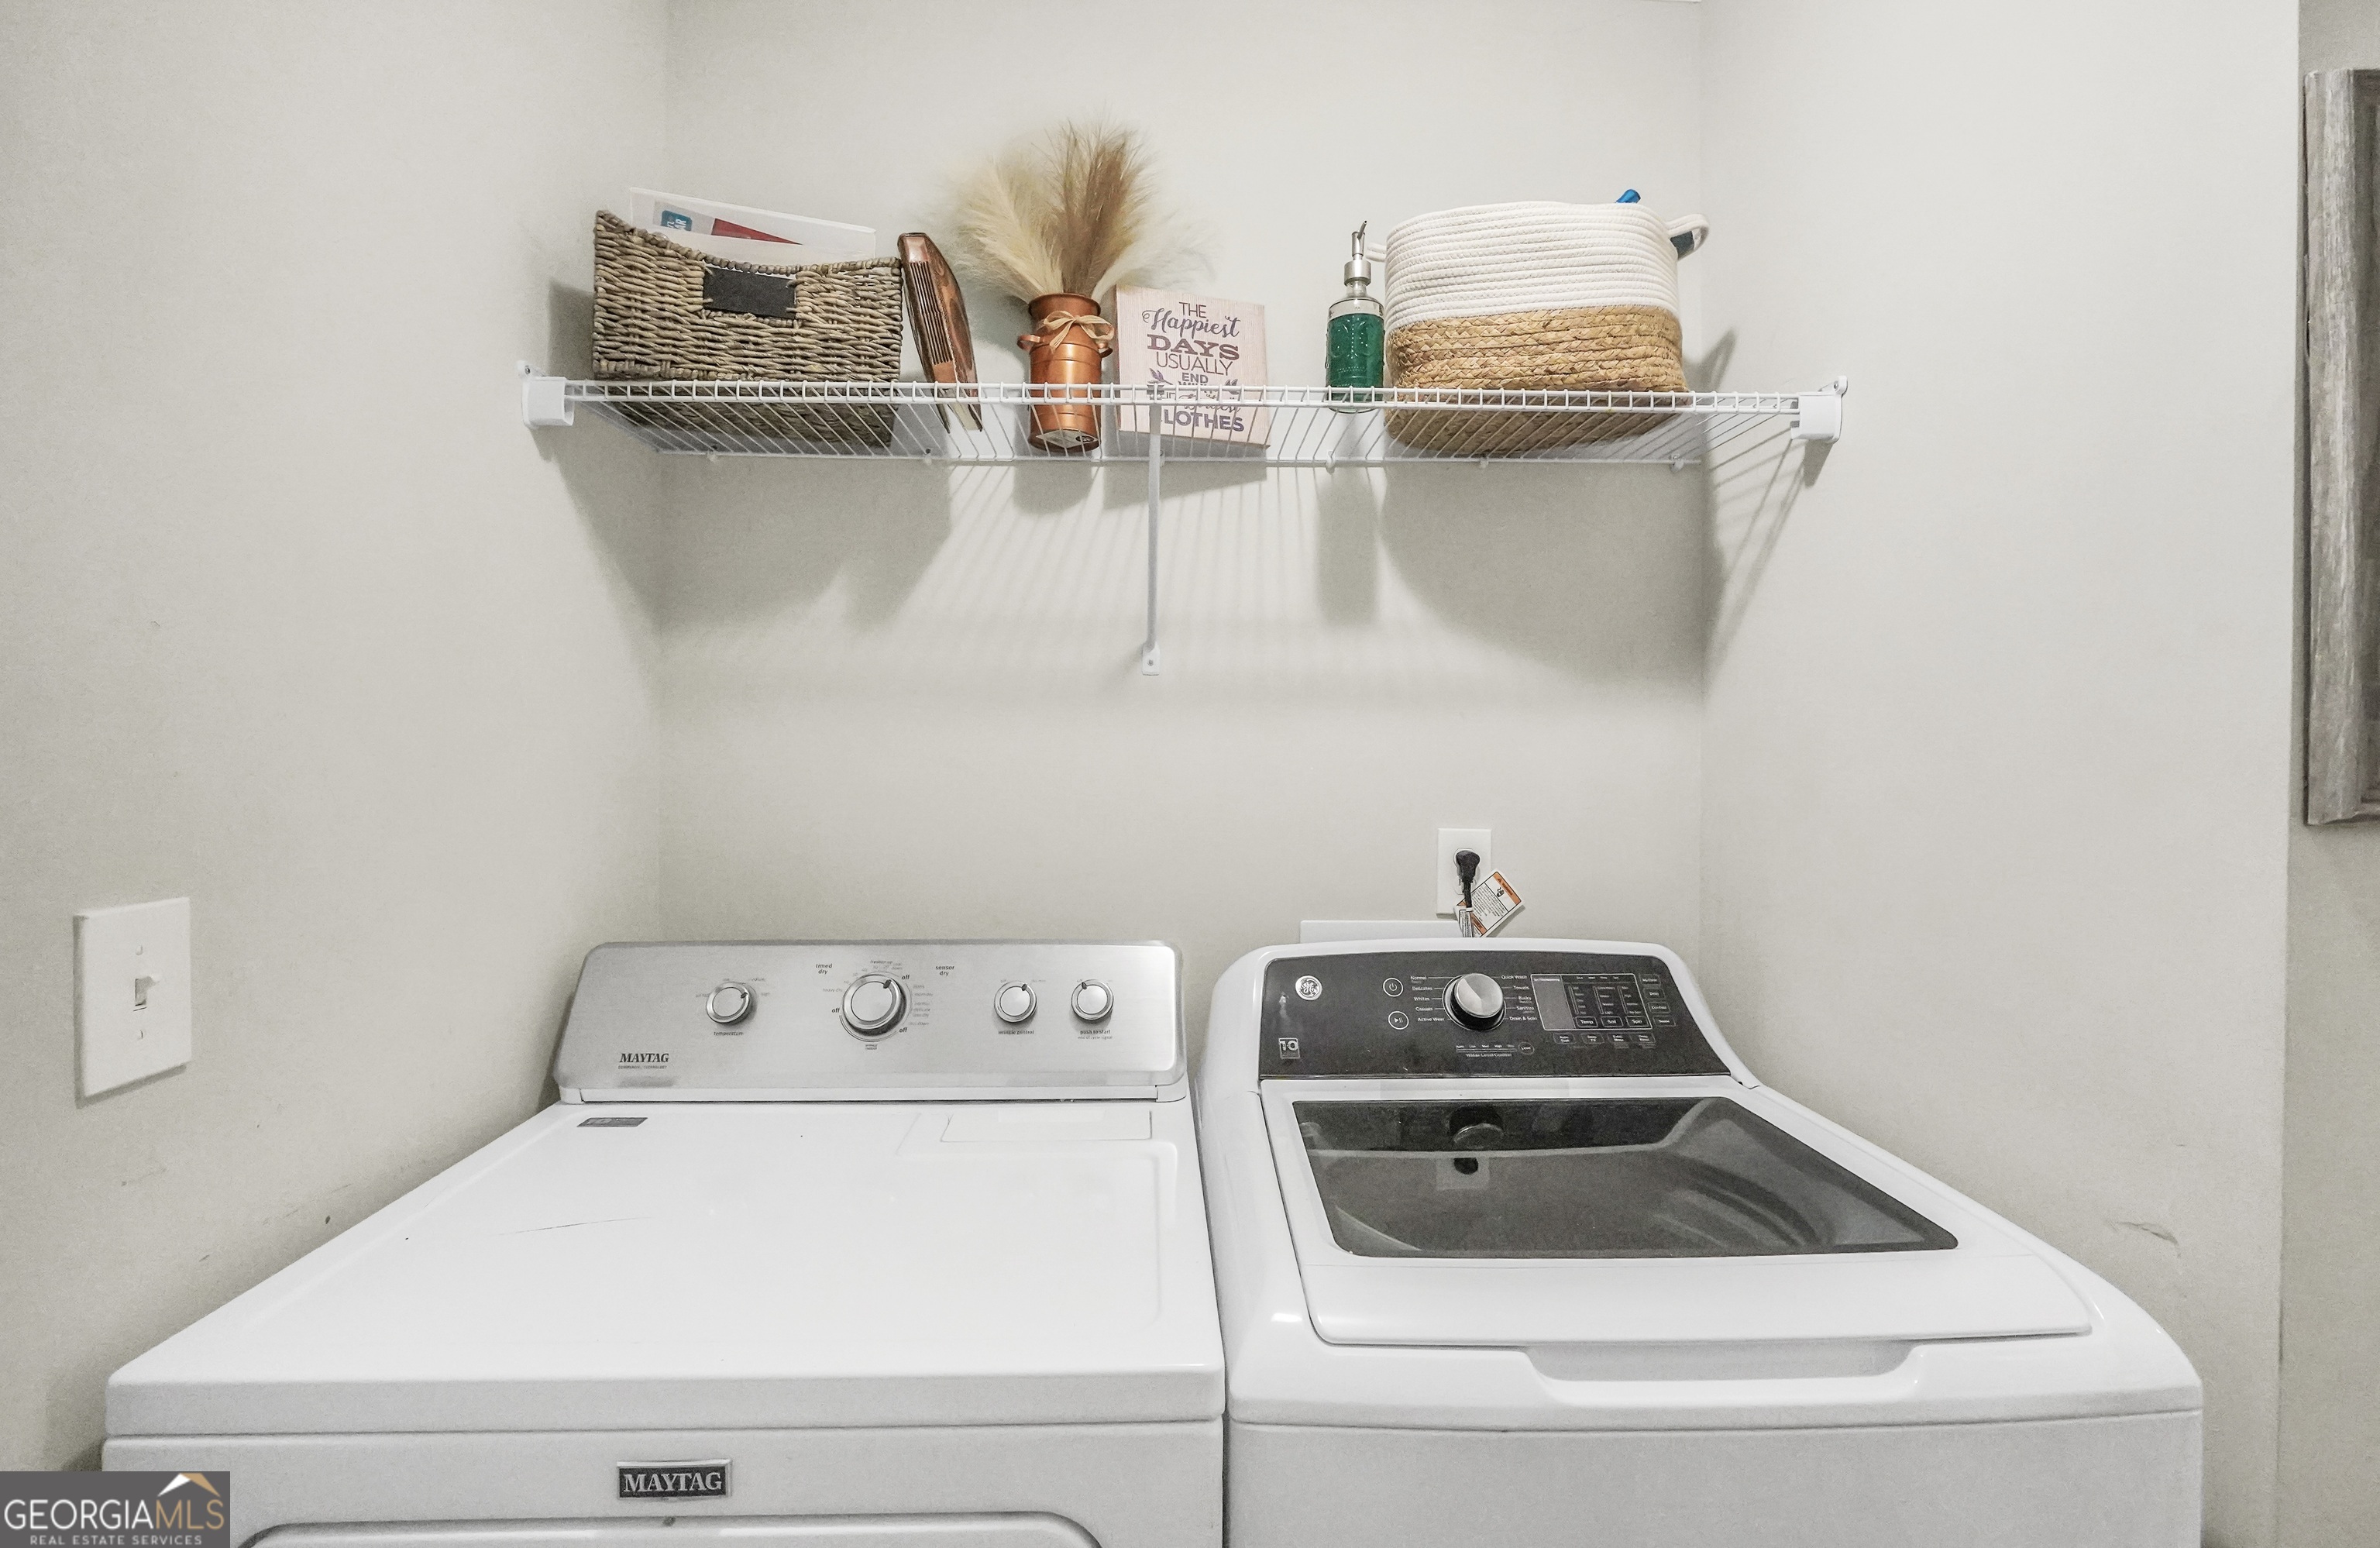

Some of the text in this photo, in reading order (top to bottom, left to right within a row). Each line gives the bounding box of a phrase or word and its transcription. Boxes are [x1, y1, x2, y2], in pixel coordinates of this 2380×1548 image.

[1178, 301, 1207, 319] THE
[1142, 308, 1241, 339] Happiest
[1147, 333, 1240, 361] DAYS
[1156, 351, 1233, 377] USUALLY
[1181, 372, 1209, 384] END
[1161, 408, 1245, 432] LOTHES
[1280, 1040, 1298, 1051] 10
[619, 1053, 669, 1063] MAYTAG
[623, 1472, 722, 1492] MAYTAG
